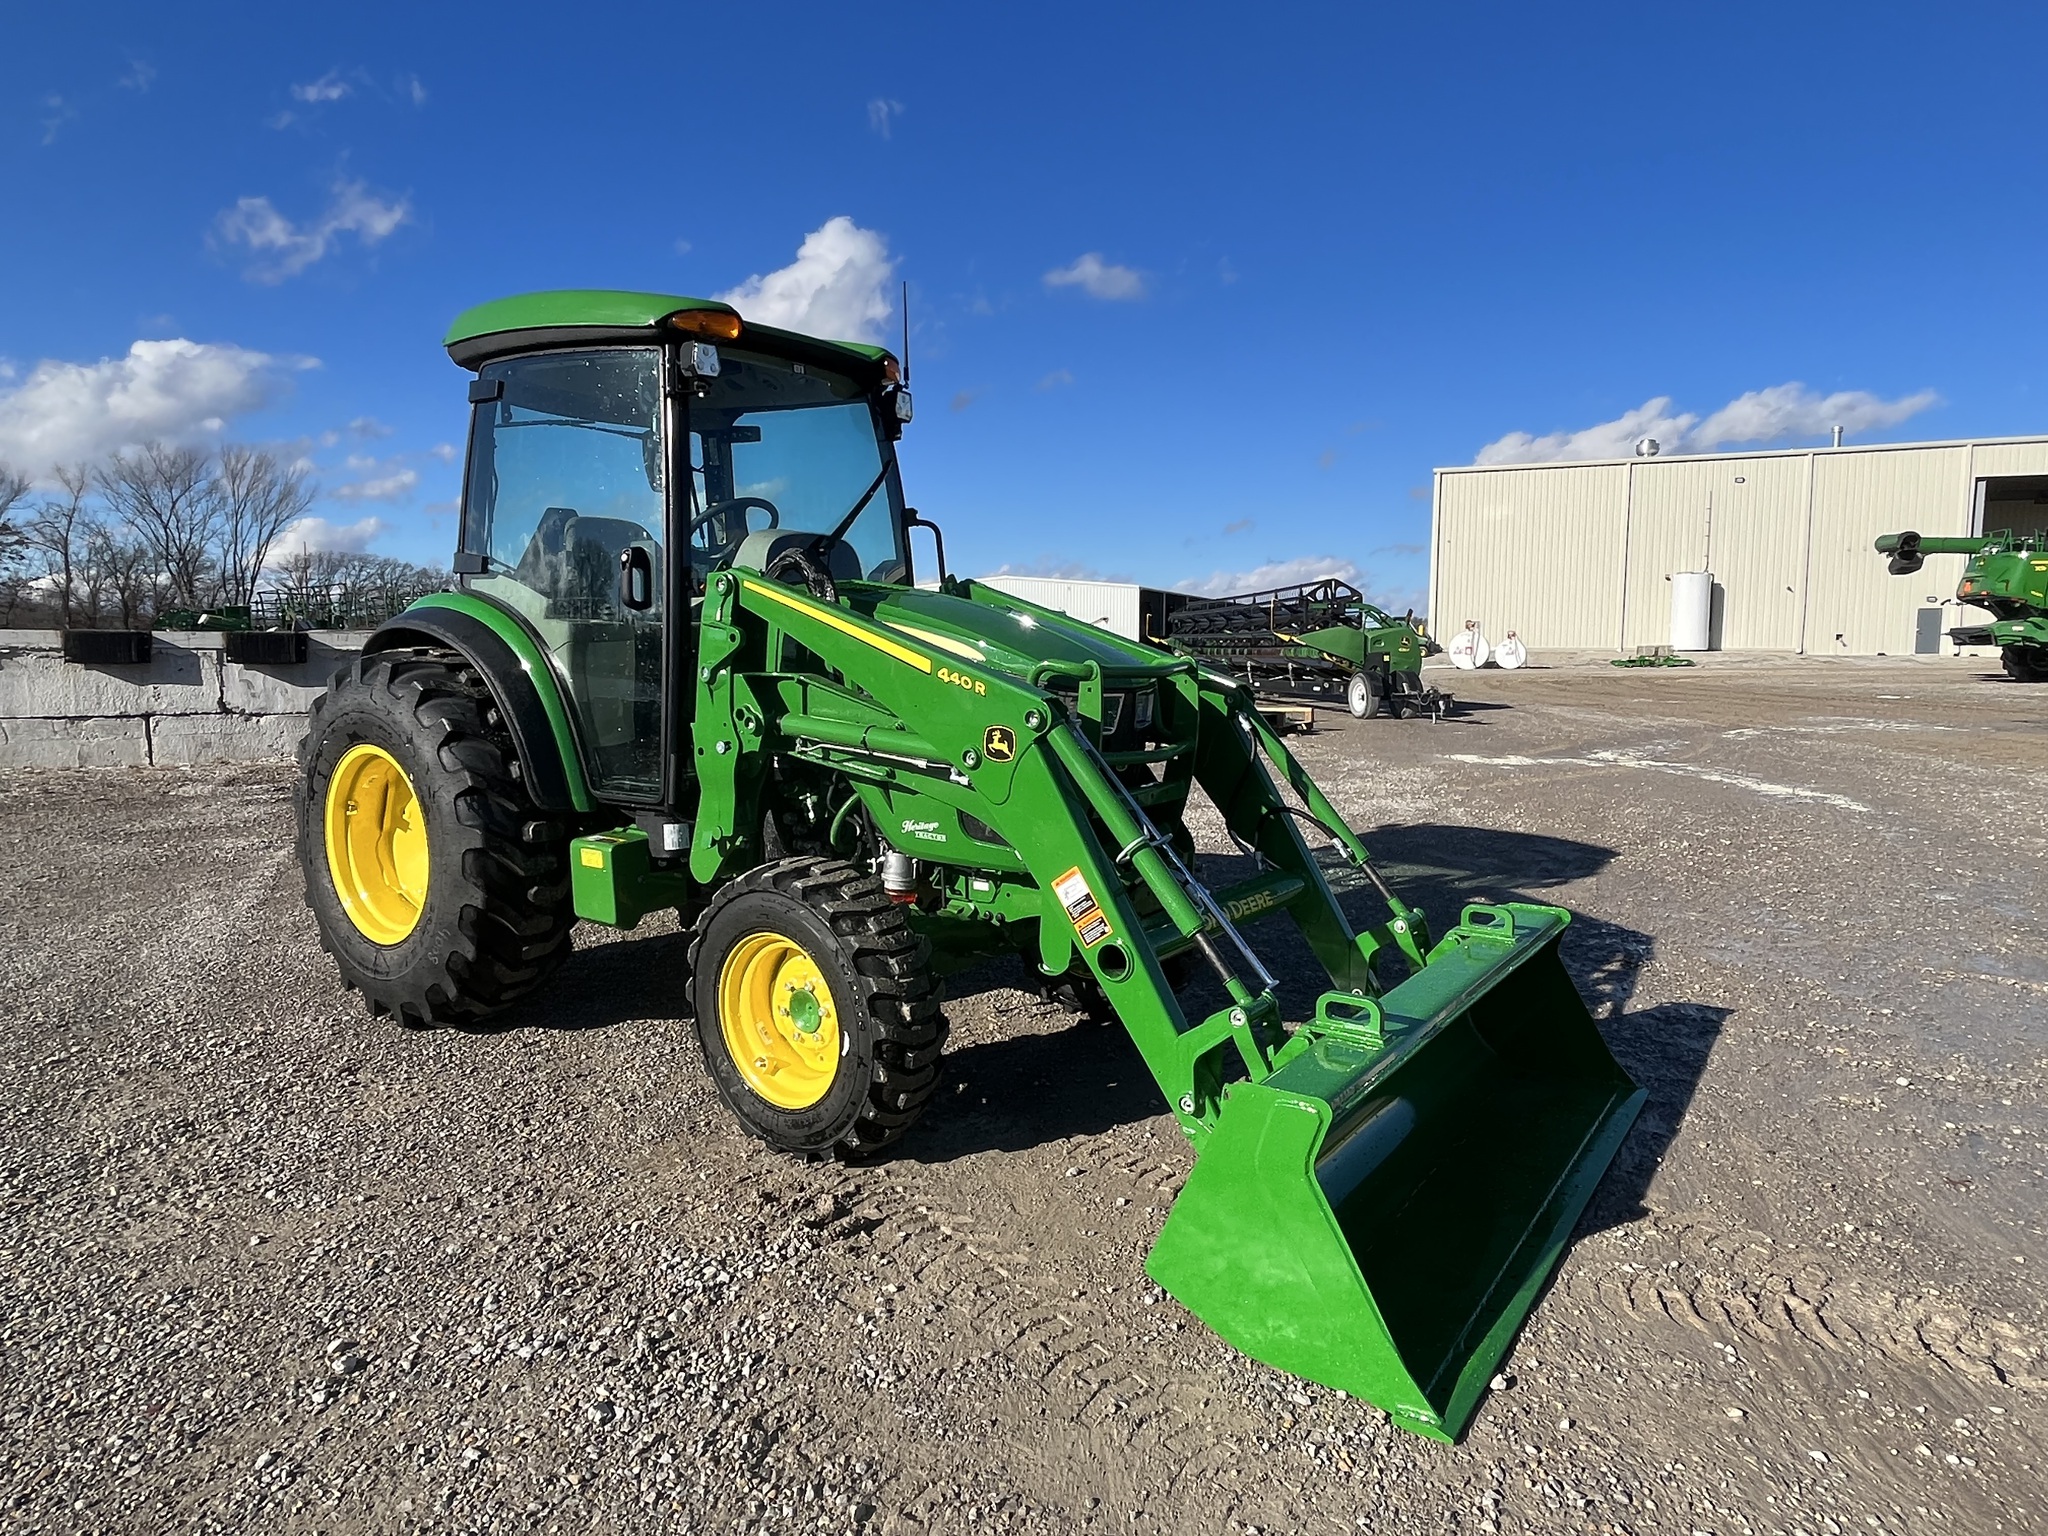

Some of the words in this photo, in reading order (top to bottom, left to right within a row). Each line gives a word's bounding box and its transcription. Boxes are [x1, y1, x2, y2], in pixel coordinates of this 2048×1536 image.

[937, 667, 973, 691] 440
[975, 681, 987, 697] R
[901, 819, 939, 834] Heritage
[1228, 890, 1274, 919] DEERE
